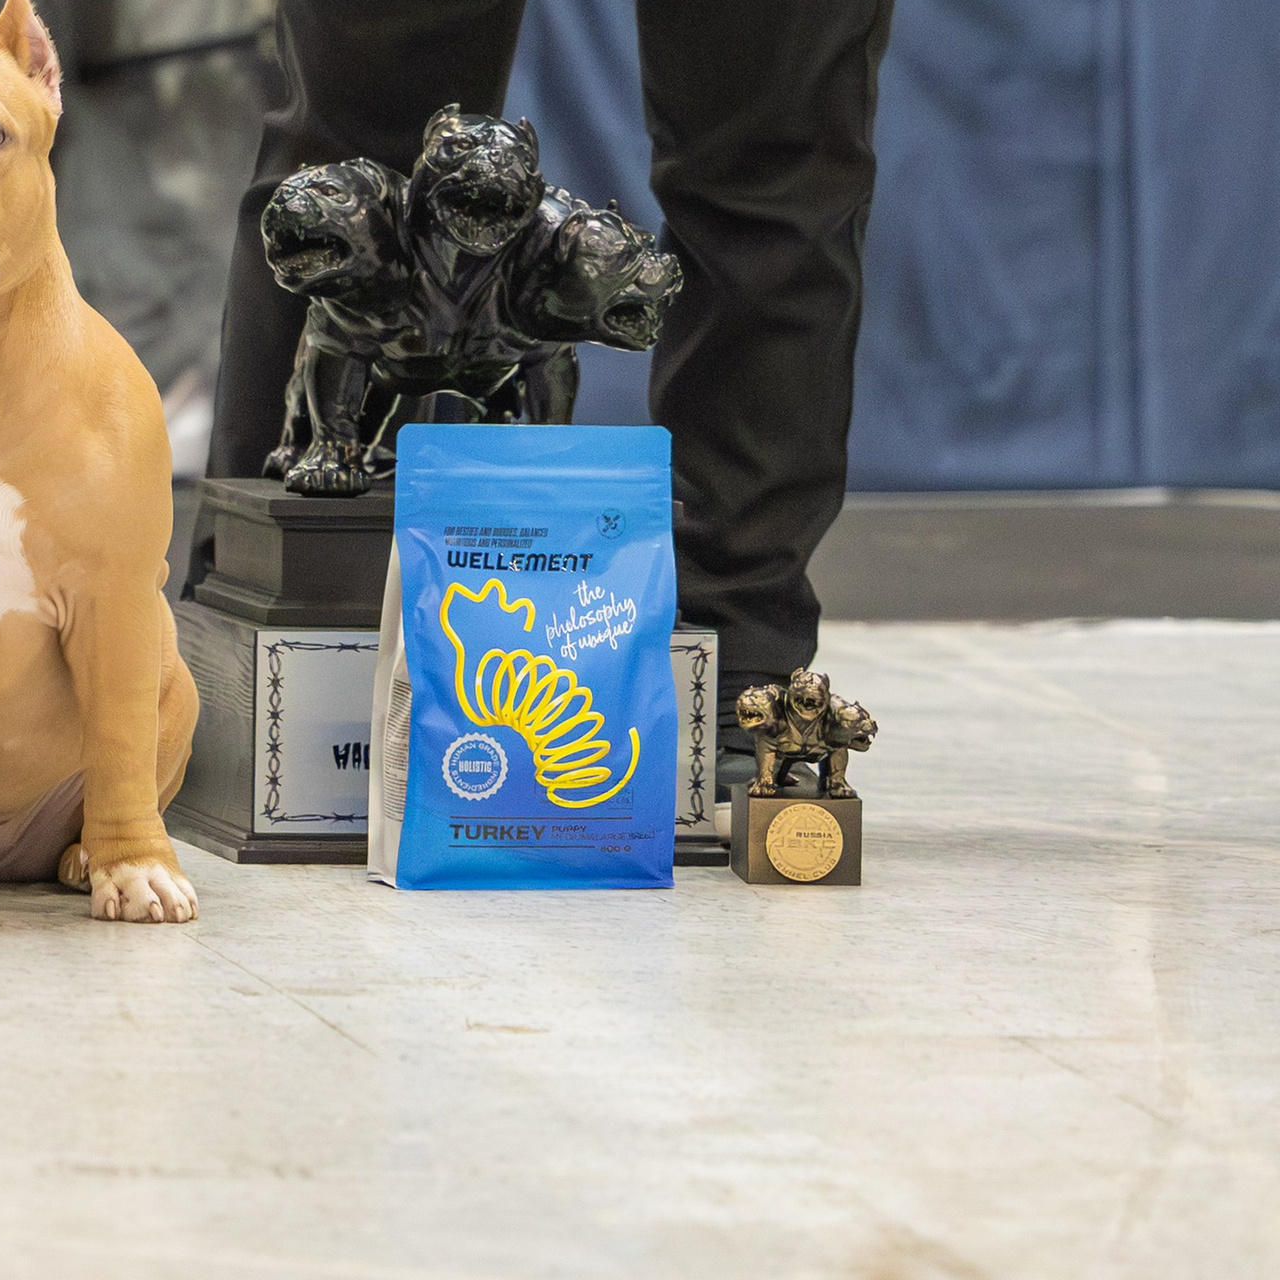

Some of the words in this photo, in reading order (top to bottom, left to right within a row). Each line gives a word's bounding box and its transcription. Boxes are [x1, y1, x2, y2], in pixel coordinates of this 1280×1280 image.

[447, 550, 593, 572] WELLEMENT
[573, 580, 606, 608] the
[545, 591, 637, 648] philosophy
[560, 632, 578, 661] of
[578, 621, 634, 650] unique
[451, 742, 477, 767] HUMAN
[478, 742, 500, 767] GRADE
[458, 760, 492, 773] HOLISTIC
[451, 770, 499, 792] INGREDIENTS
[449, 824, 546, 840] TURKEY
[796, 831, 833, 839] RUSSIA
